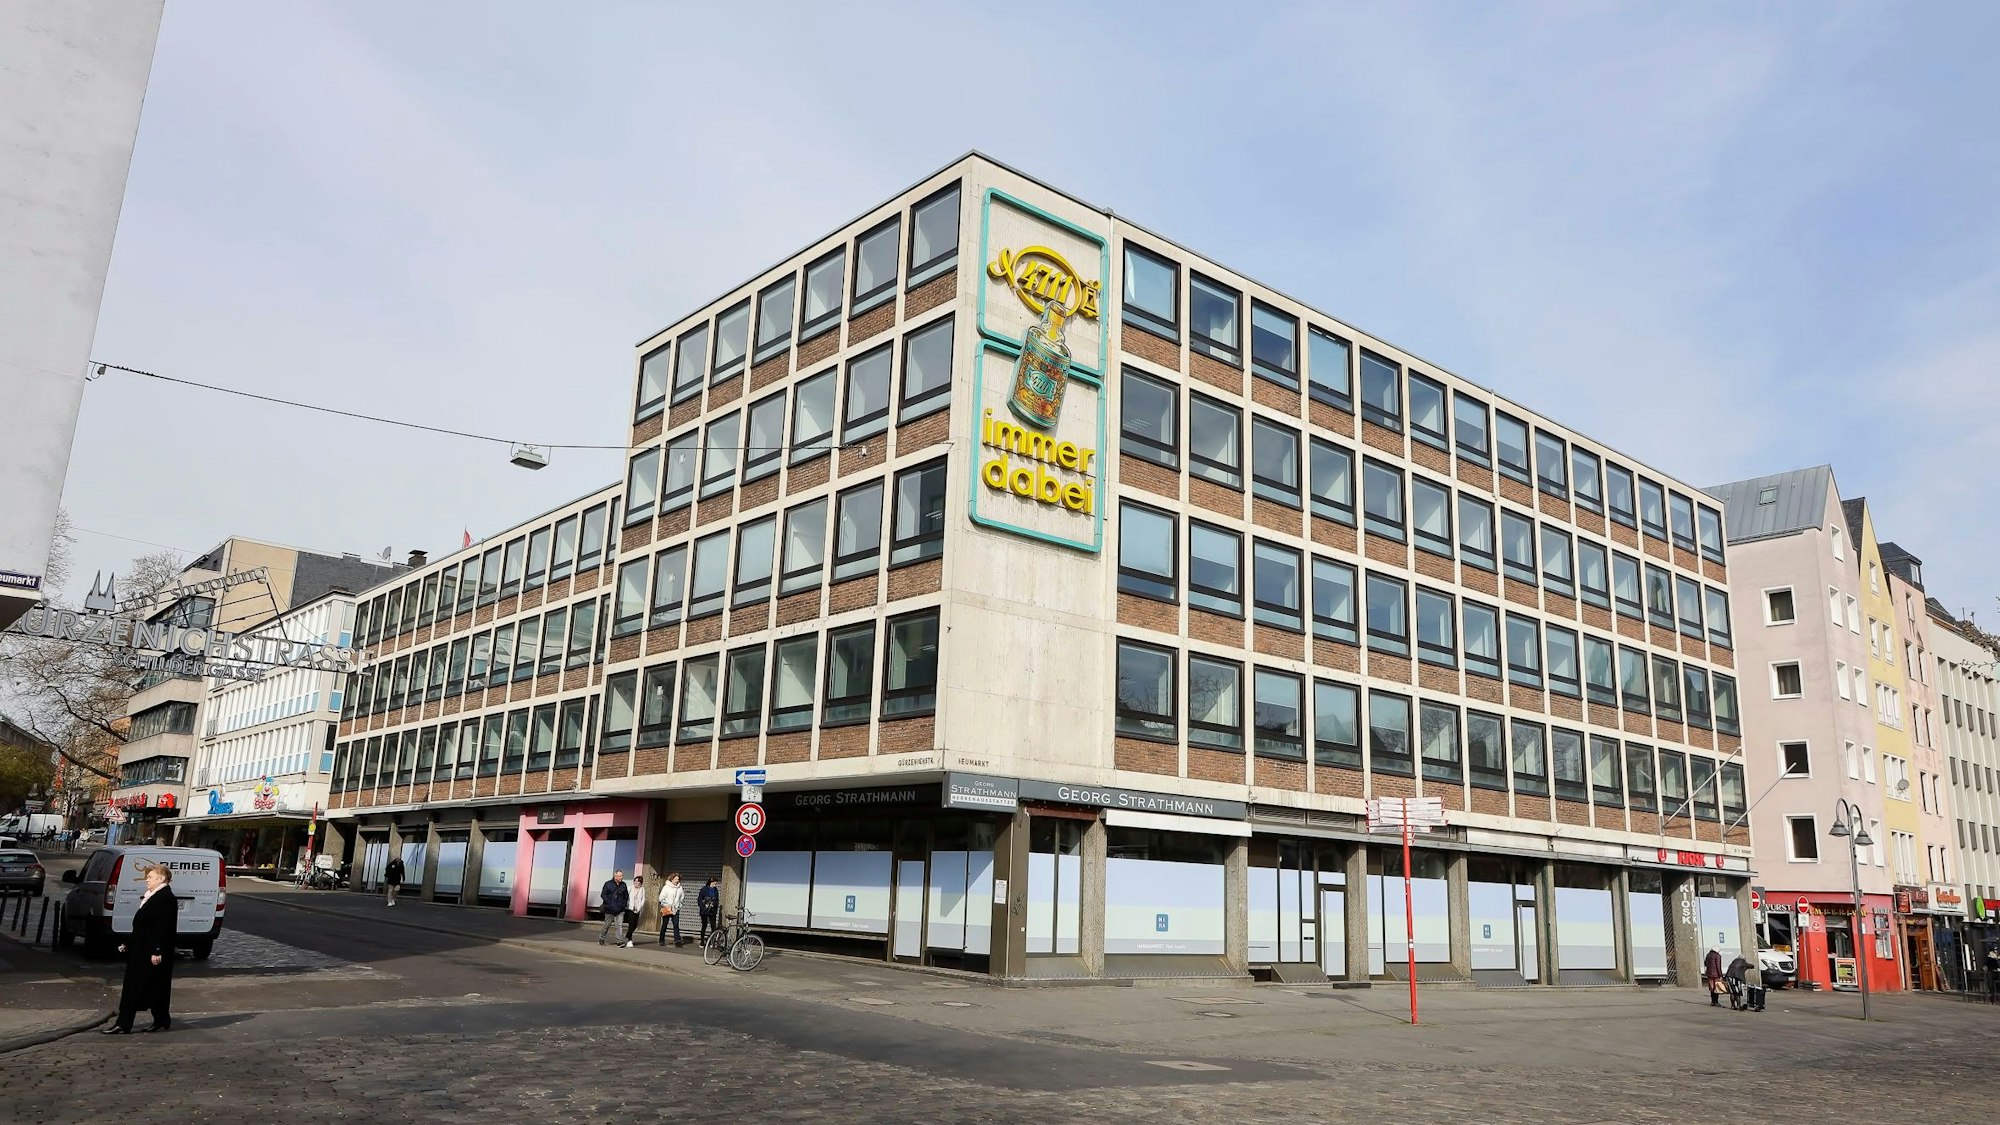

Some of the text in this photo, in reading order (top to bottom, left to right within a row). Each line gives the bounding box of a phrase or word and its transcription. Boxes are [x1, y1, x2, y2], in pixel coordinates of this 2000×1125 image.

[1018, 260, 1073, 306] 4711
[982, 408, 1096, 472] immer
[981, 453, 1092, 513] dabei
[121, 566, 268, 611] city shopping
[112, 650, 267, 682] SCHILDER GASSE
[795, 790, 916, 806] GEORG STRATHMANN
[951, 784, 1017, 799] STRATHMANN
[1058, 786, 1214, 815] GEORG STRATHMANN
[742, 811, 759, 826] 30
[1680, 884, 1692, 925] KIOSK
